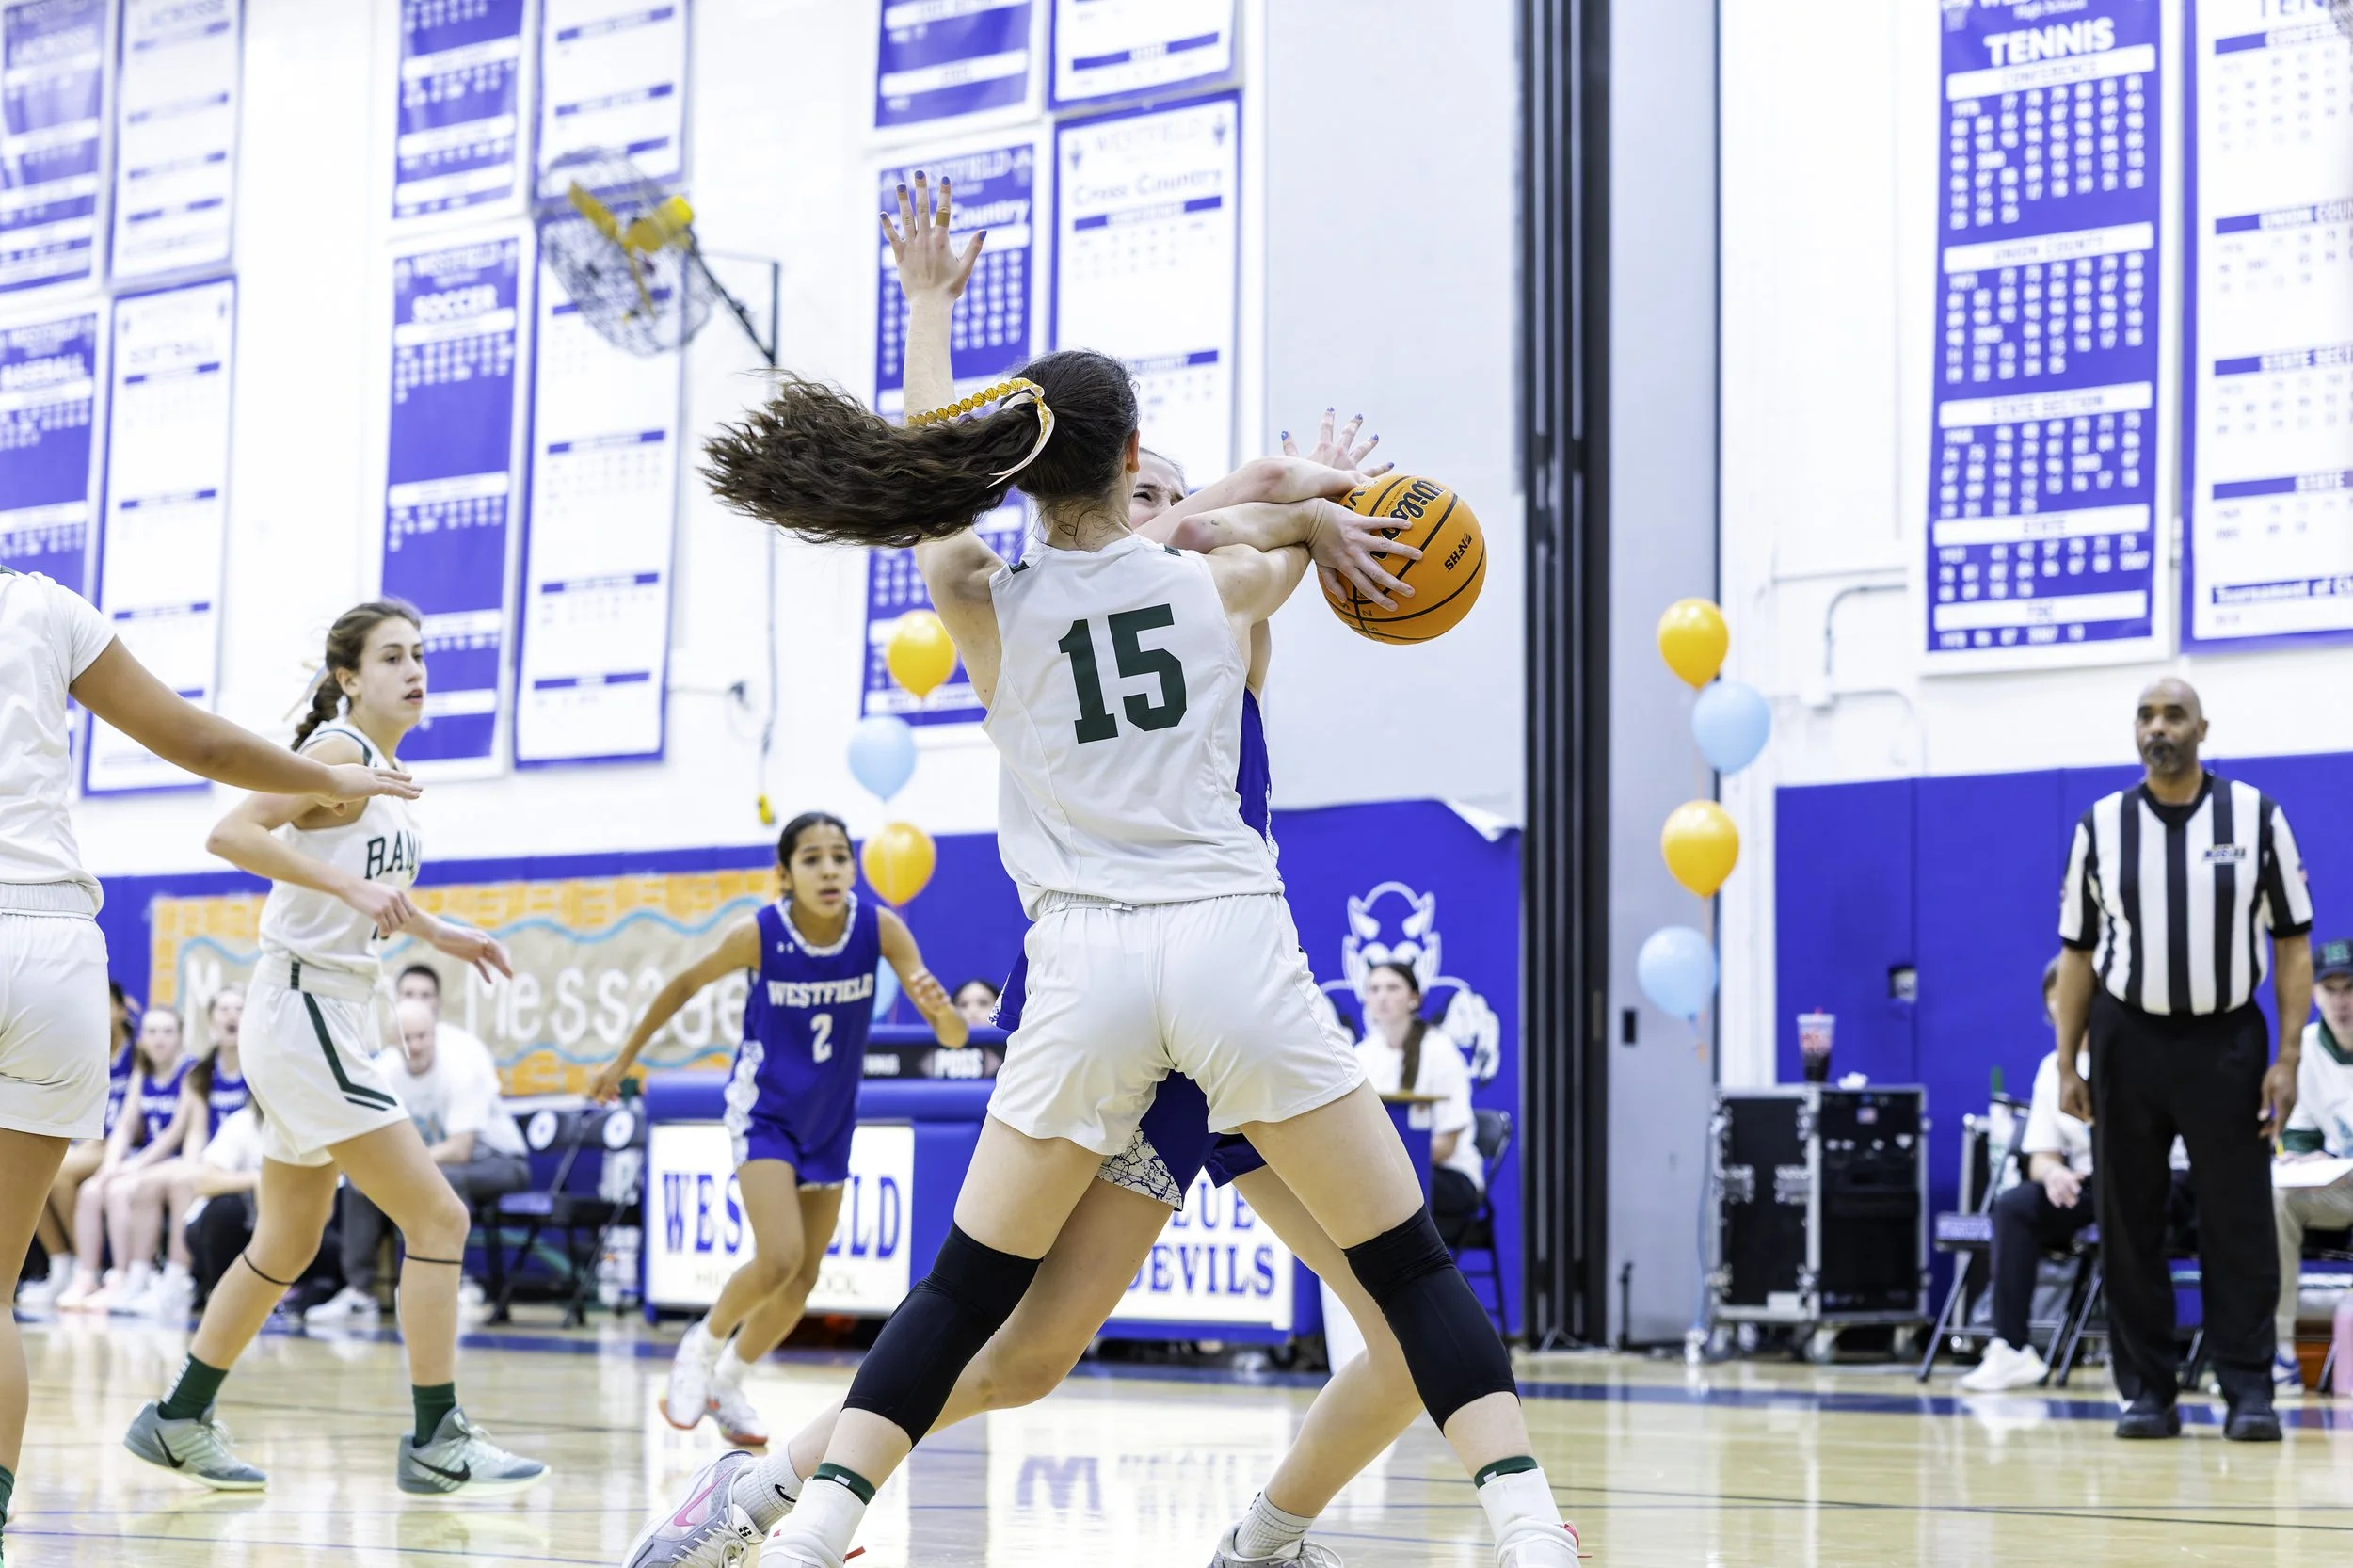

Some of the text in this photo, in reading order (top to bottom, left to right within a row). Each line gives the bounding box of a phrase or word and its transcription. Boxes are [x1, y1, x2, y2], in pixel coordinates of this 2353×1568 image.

[1983, 16, 2116, 67] TENNIS
[1444, 536, 1470, 571] NFHS
[1058, 603, 1187, 744] 15
[767, 973, 873, 1008] WESTFIELD
[810, 1013, 833, 1063] 2
